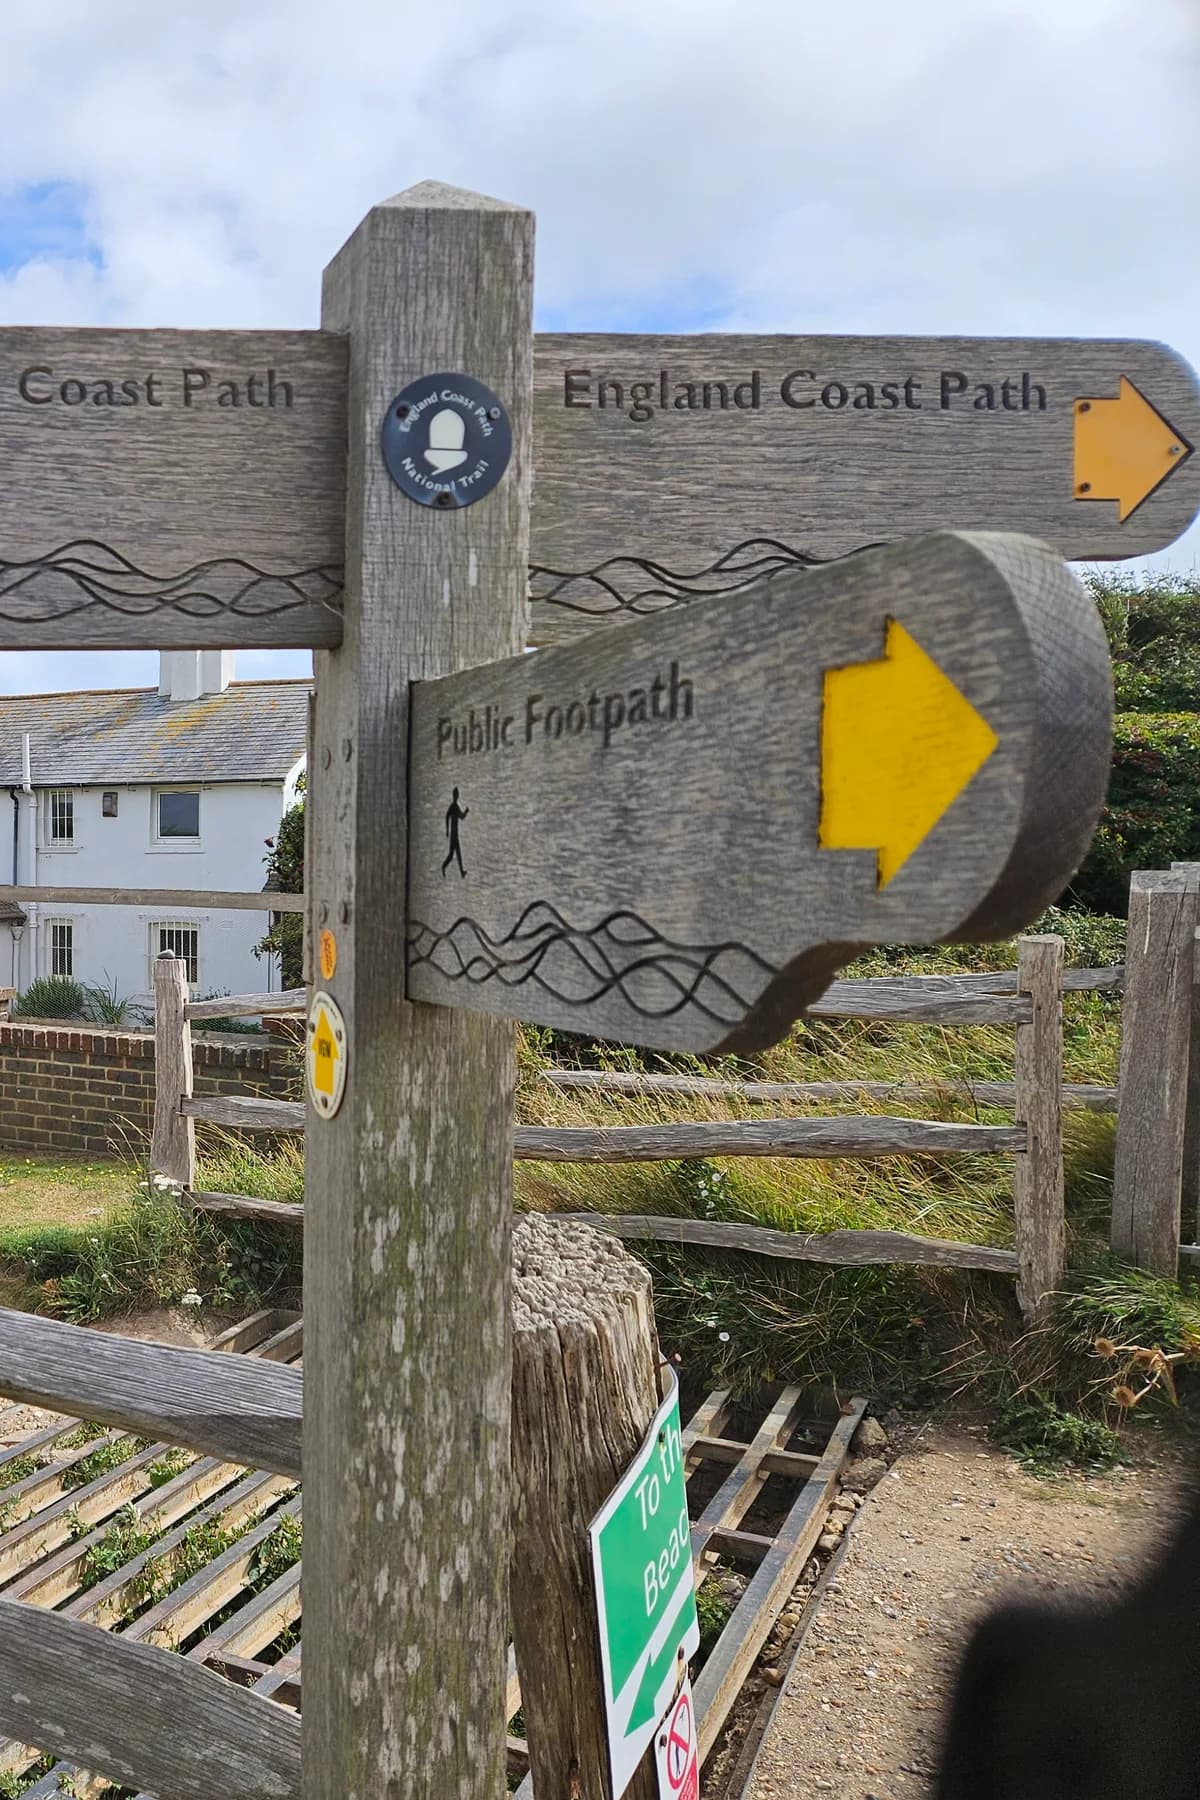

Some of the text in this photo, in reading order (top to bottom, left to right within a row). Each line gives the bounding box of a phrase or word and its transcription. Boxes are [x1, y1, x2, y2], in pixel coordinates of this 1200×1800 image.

[18, 365, 162, 407] Coast
[182, 367, 294, 408] Path
[399, 389, 494, 437] England Coast Path
[564, 369, 1047, 422] England Coast Path
[401, 457, 489, 492] National Trail
[437, 660, 694, 760] Public Footpath
[635, 1423, 682, 1530] To th
[644, 1507, 689, 1617] Beac
